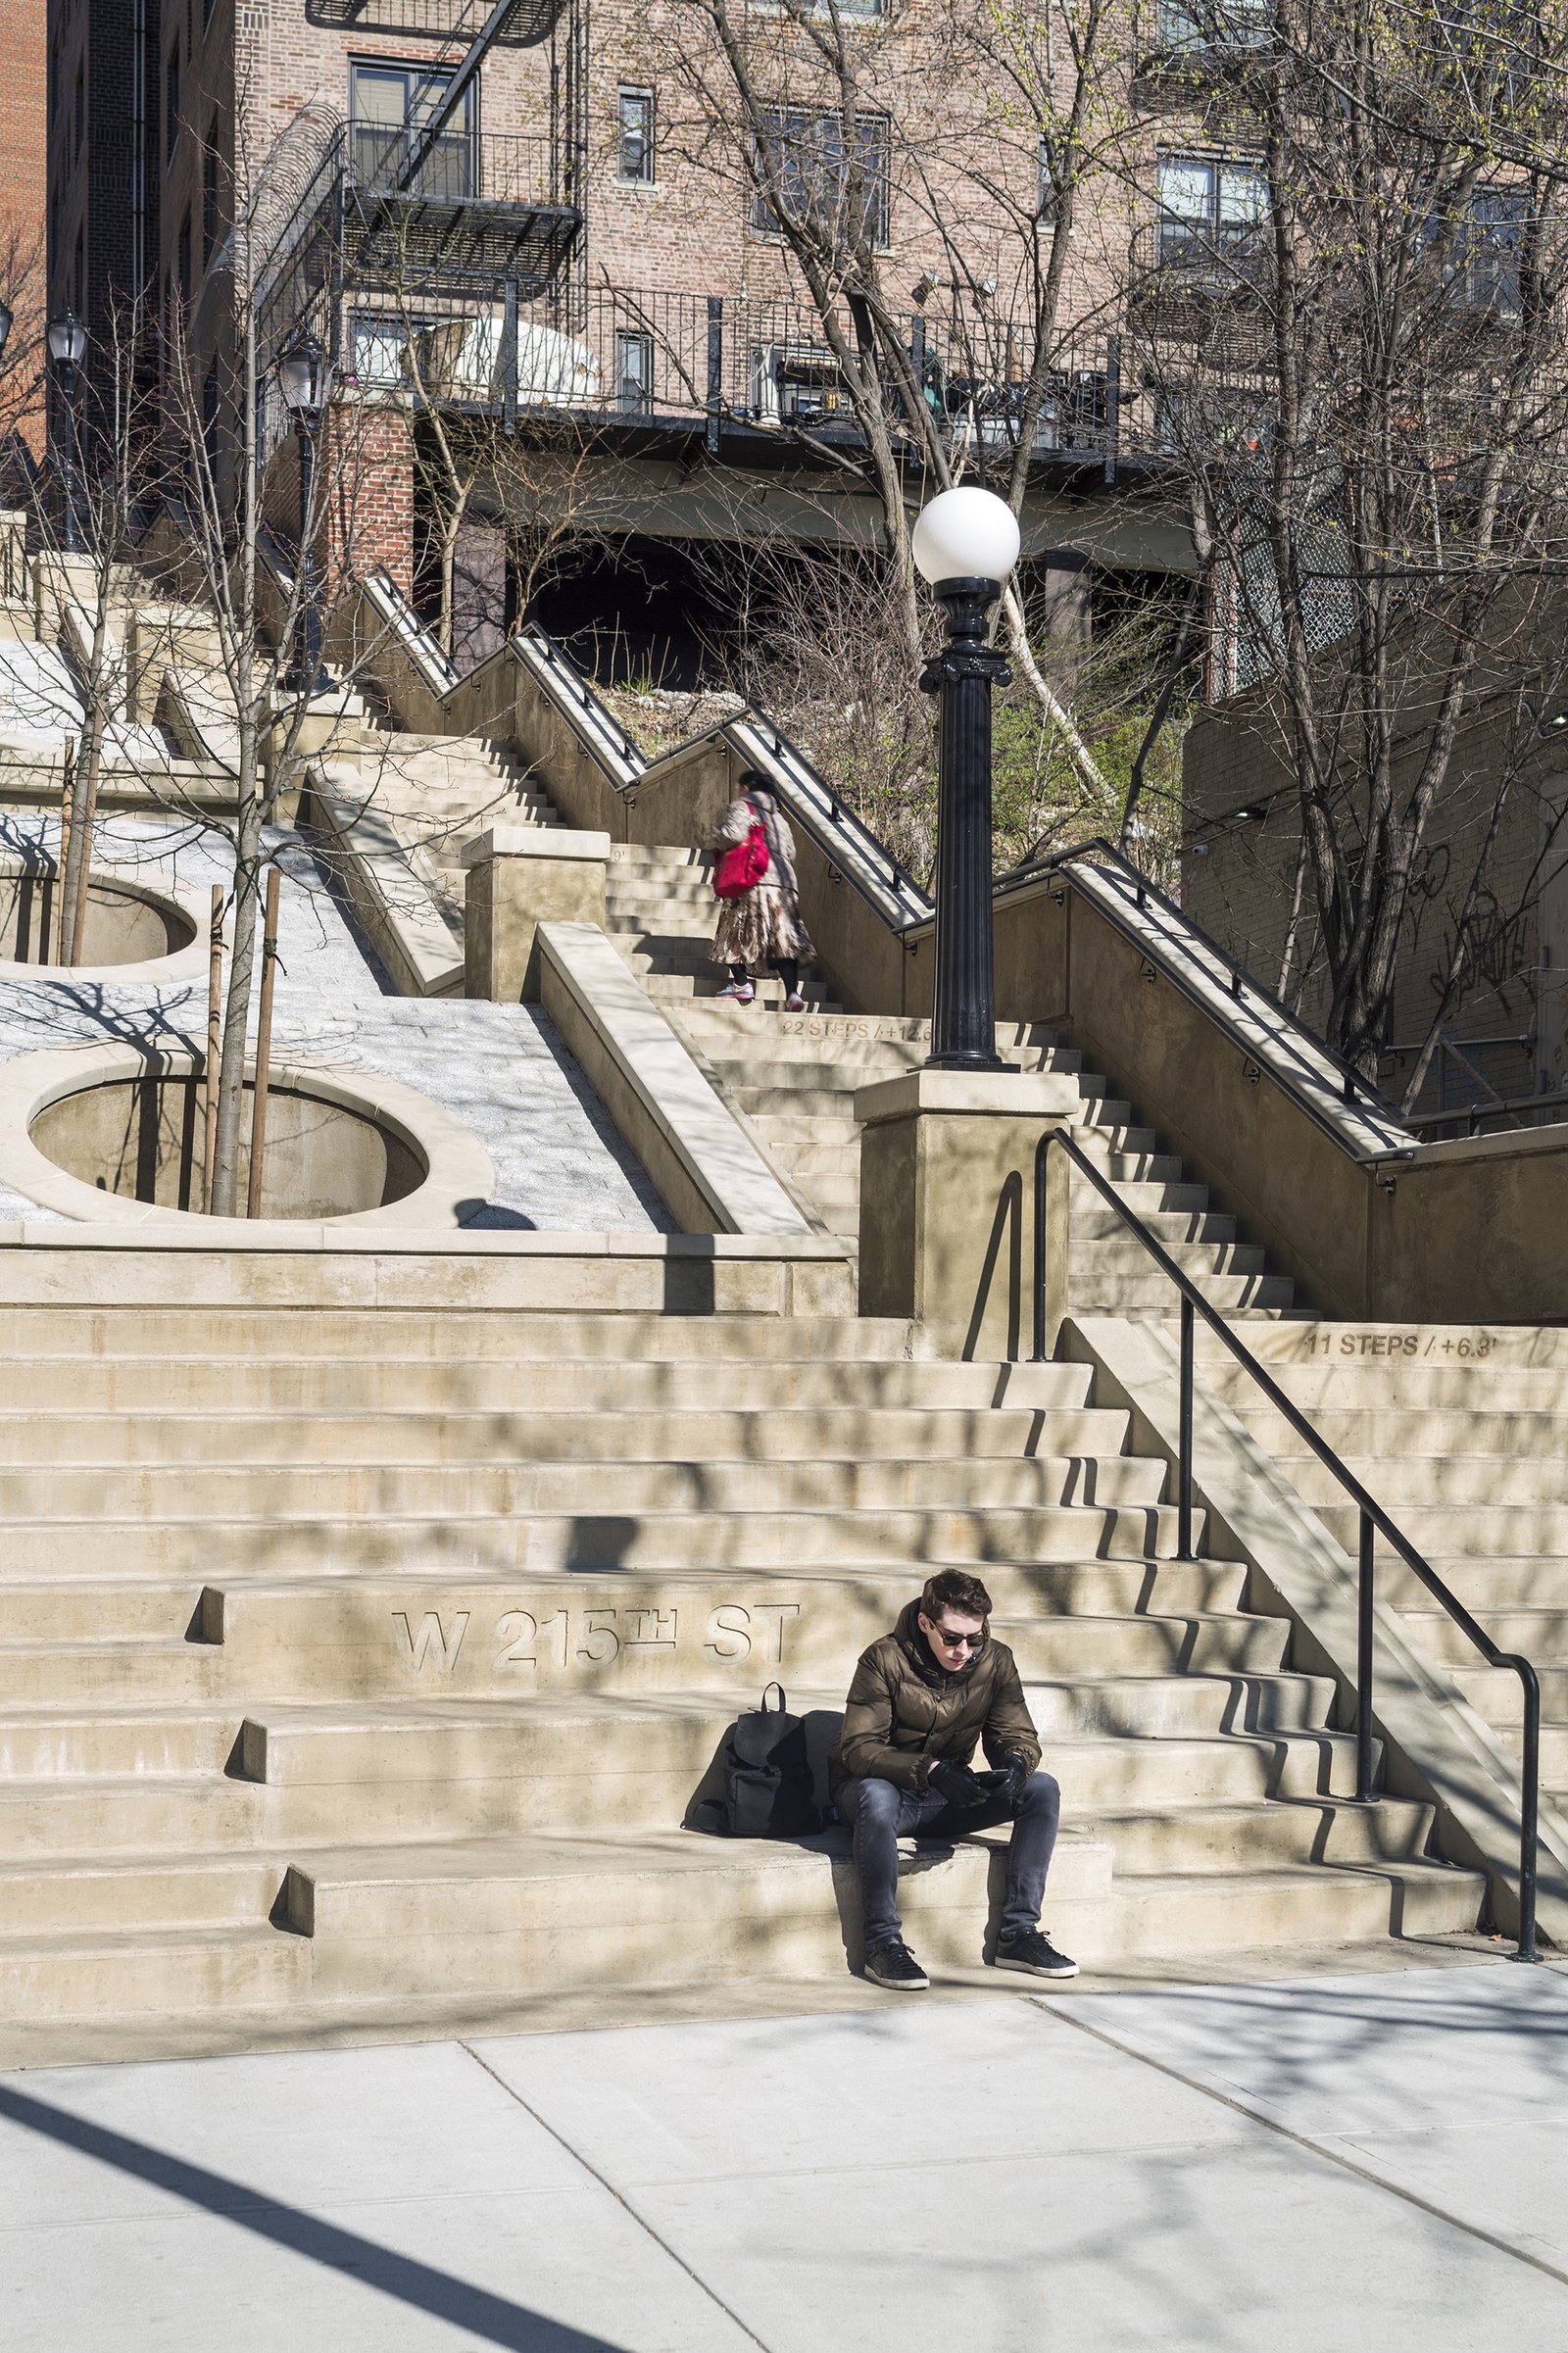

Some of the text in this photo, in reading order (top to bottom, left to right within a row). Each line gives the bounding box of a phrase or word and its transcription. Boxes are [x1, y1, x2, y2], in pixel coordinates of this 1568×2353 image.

[784, 1020, 804, 1036] 22
[809, 1021, 869, 1039] STEPS
[1307, 1334, 1497, 1358] 11 STEPS / +6.3'
[391, 1603, 801, 1672] W 215TH ST
